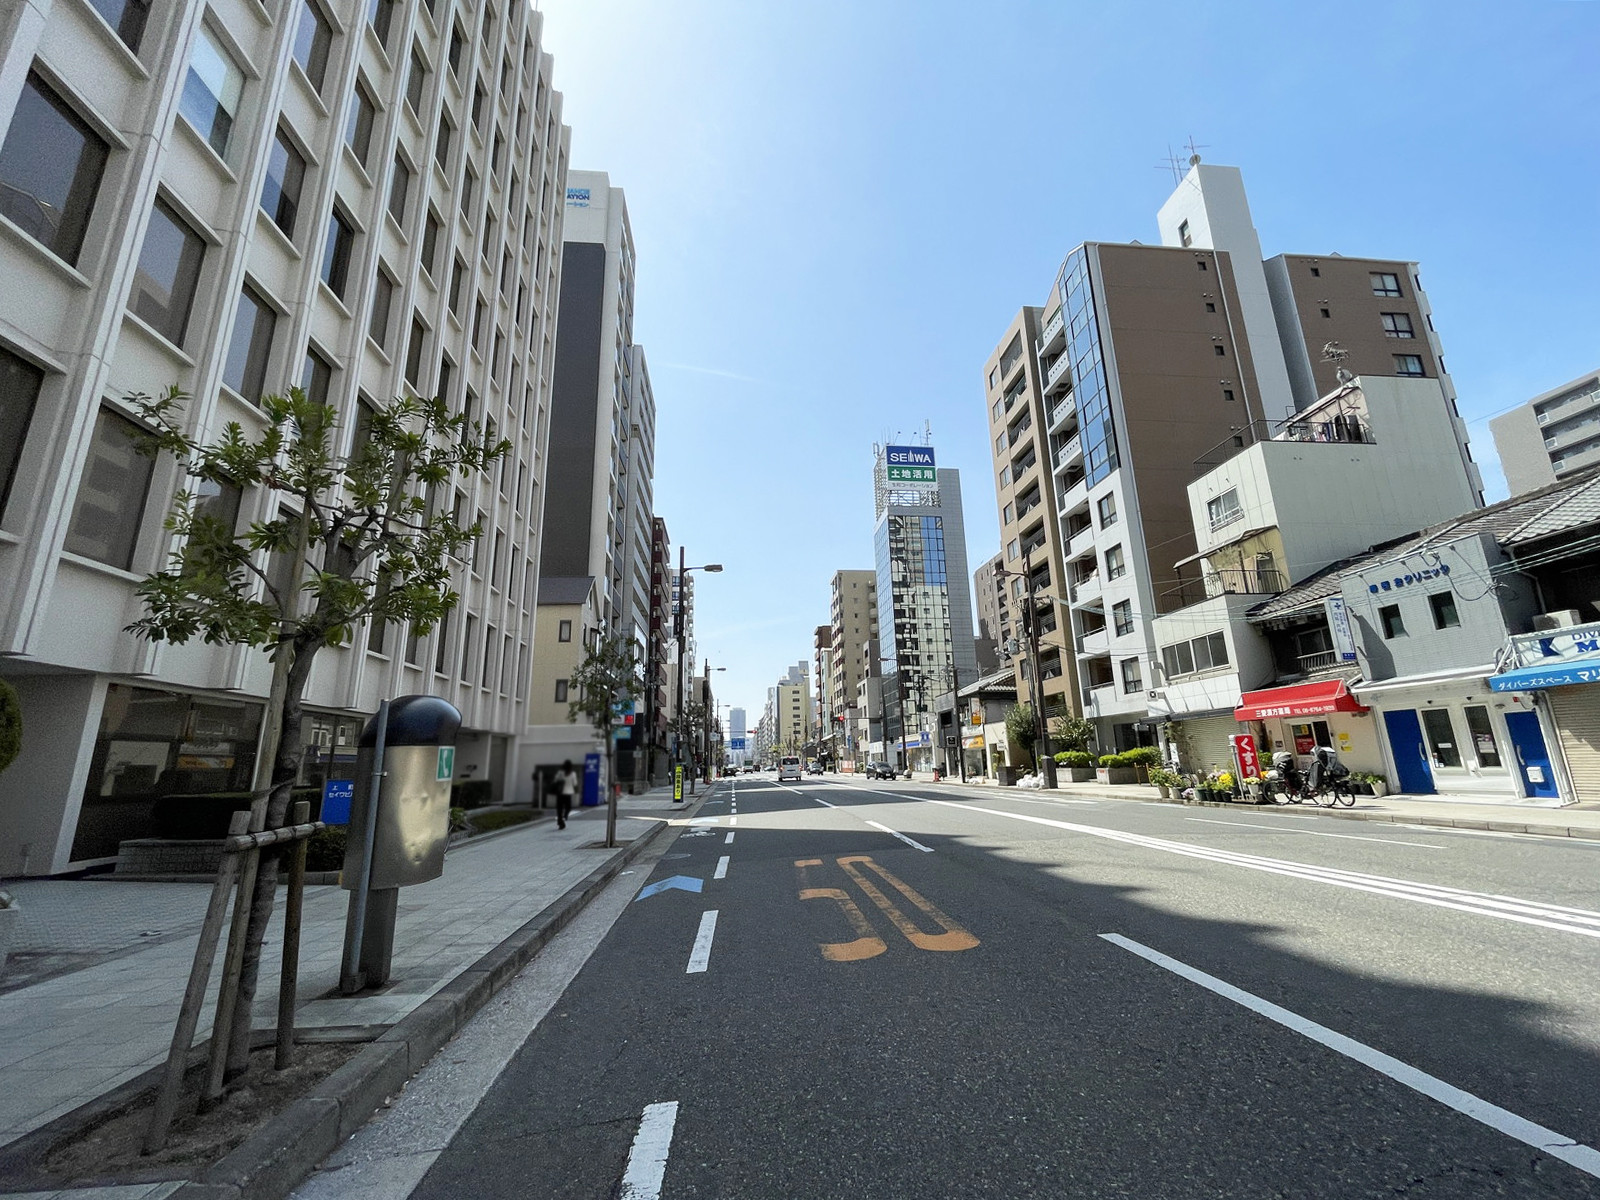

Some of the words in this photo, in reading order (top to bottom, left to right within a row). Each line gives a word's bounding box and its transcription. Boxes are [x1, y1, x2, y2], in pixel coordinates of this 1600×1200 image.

[890, 450, 931, 463] SEIWA
[891, 469, 932, 479] 土地活用
[1241, 737, 1257, 777] くすり
